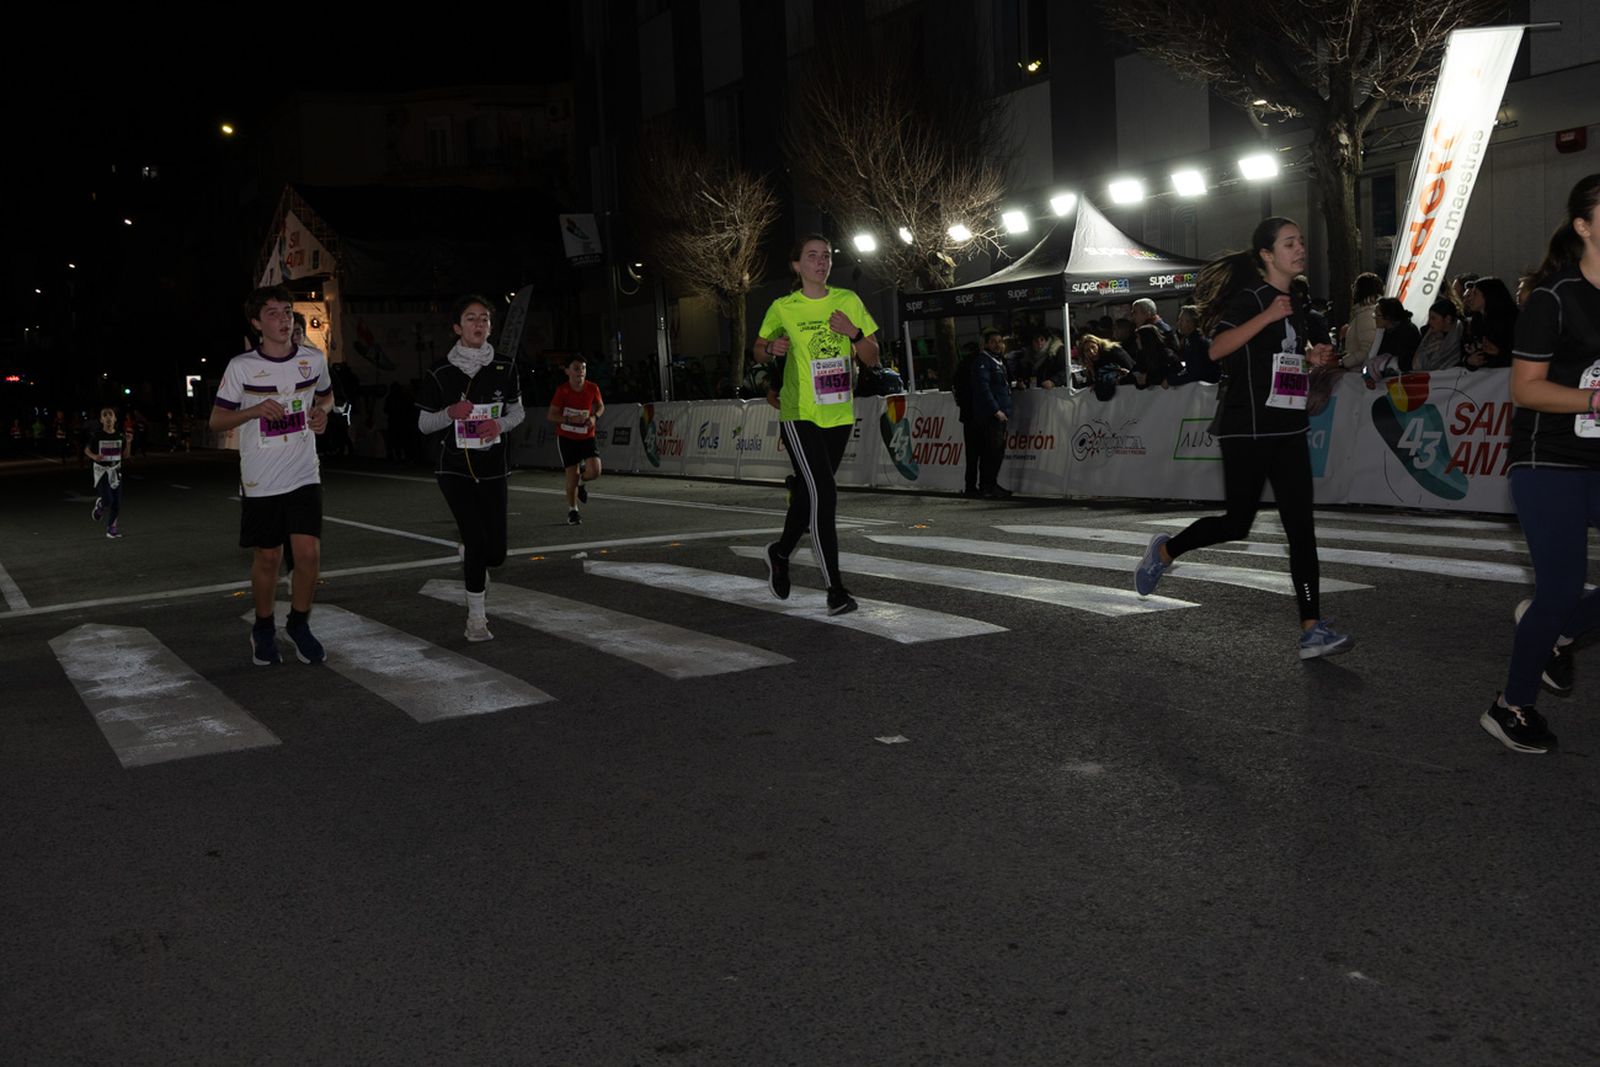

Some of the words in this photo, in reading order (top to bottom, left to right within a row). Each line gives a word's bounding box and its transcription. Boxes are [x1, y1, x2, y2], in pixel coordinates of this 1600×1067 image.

[1422, 235, 1452, 297] obras
[1445, 129, 1485, 233] maestras
[657, 420, 674, 437] SAN
[889, 426, 909, 462] 43
[912, 416, 944, 439] SAN
[1397, 417, 1443, 470] 43
[908, 435, 964, 466] ANTÓN
